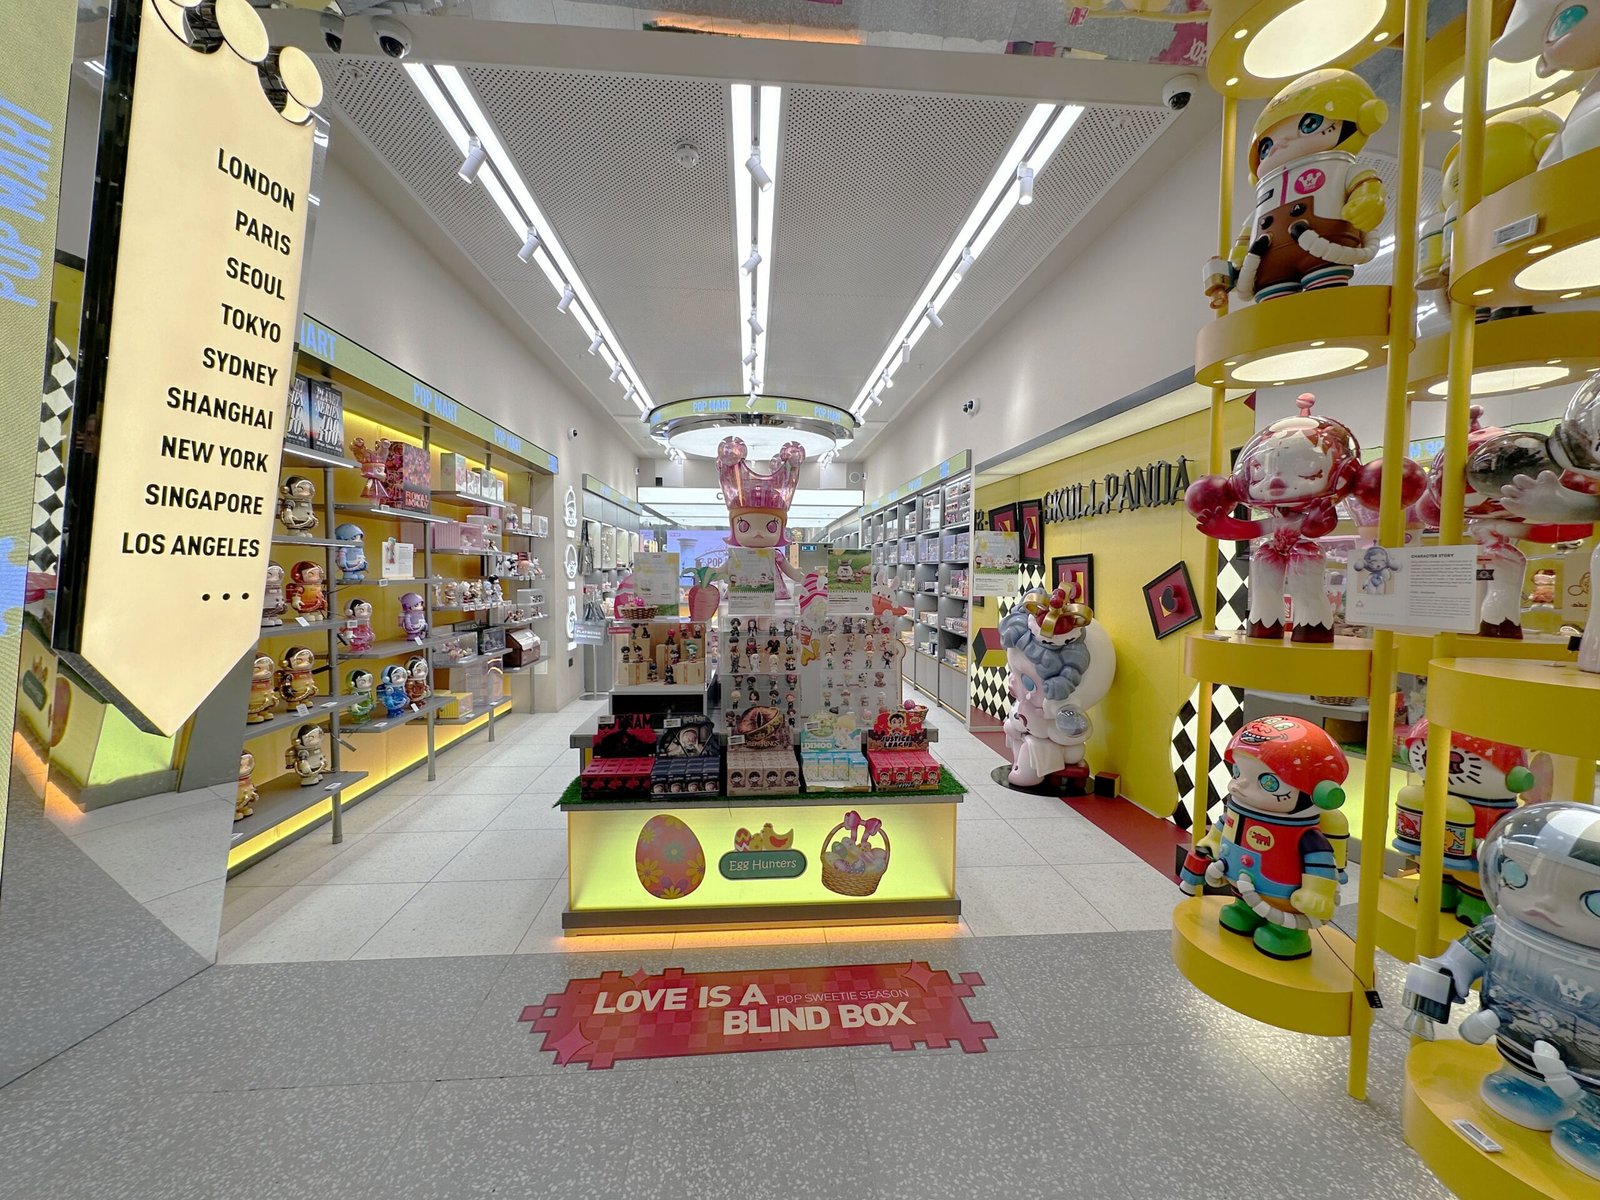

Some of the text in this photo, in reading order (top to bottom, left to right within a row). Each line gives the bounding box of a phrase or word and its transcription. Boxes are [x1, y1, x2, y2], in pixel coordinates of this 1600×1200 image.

[217, 147, 296, 212] LONDON
[235, 209, 292, 256] PARIS
[226, 256, 286, 301] SEOUL
[221, 302, 282, 343] TOKYO
[300, 319, 337, 362] ART
[202, 347, 278, 387] SYDNEY
[166, 386, 274, 430] SHANGHAI
[413, 382, 458, 423] POP MART
[692, 399, 732, 413] POP MART
[814, 406, 828, 419] POP
[161, 434, 269, 473] NEW YORK
[494, 426, 507, 446] POP
[145, 483, 264, 516] SINGAPORE
[1043, 454, 1190, 525] SKULLPANDA
[122, 531, 261, 558] LOS ANGELES
[729, 859, 797, 871] Egg Hunters
[592, 983, 910, 1015] LOVE IS A POP SWEETIE SEASON
[723, 1000, 917, 1036] BLIND BOX
